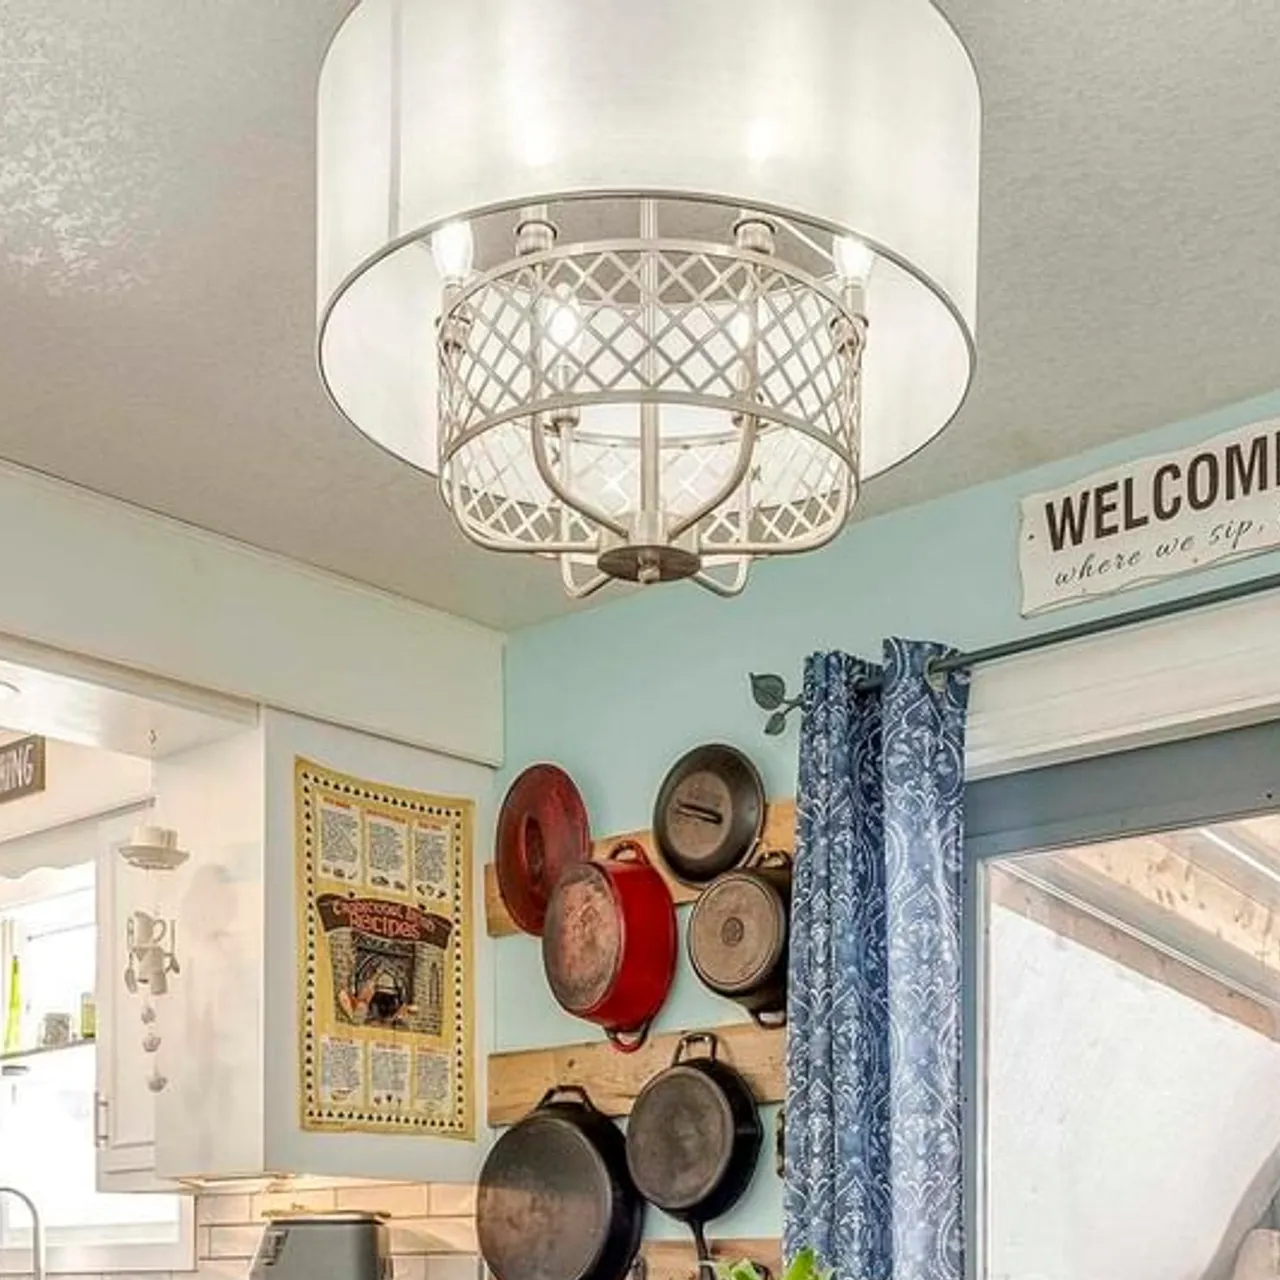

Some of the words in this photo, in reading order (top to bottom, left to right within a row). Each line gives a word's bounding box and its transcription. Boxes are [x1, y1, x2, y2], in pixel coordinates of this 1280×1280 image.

[1055, 547, 1141, 586] where
[1156, 535, 1195, 556] we
[1209, 520, 1264, 549] sip,
[350, 912, 420, 939] Recipes
